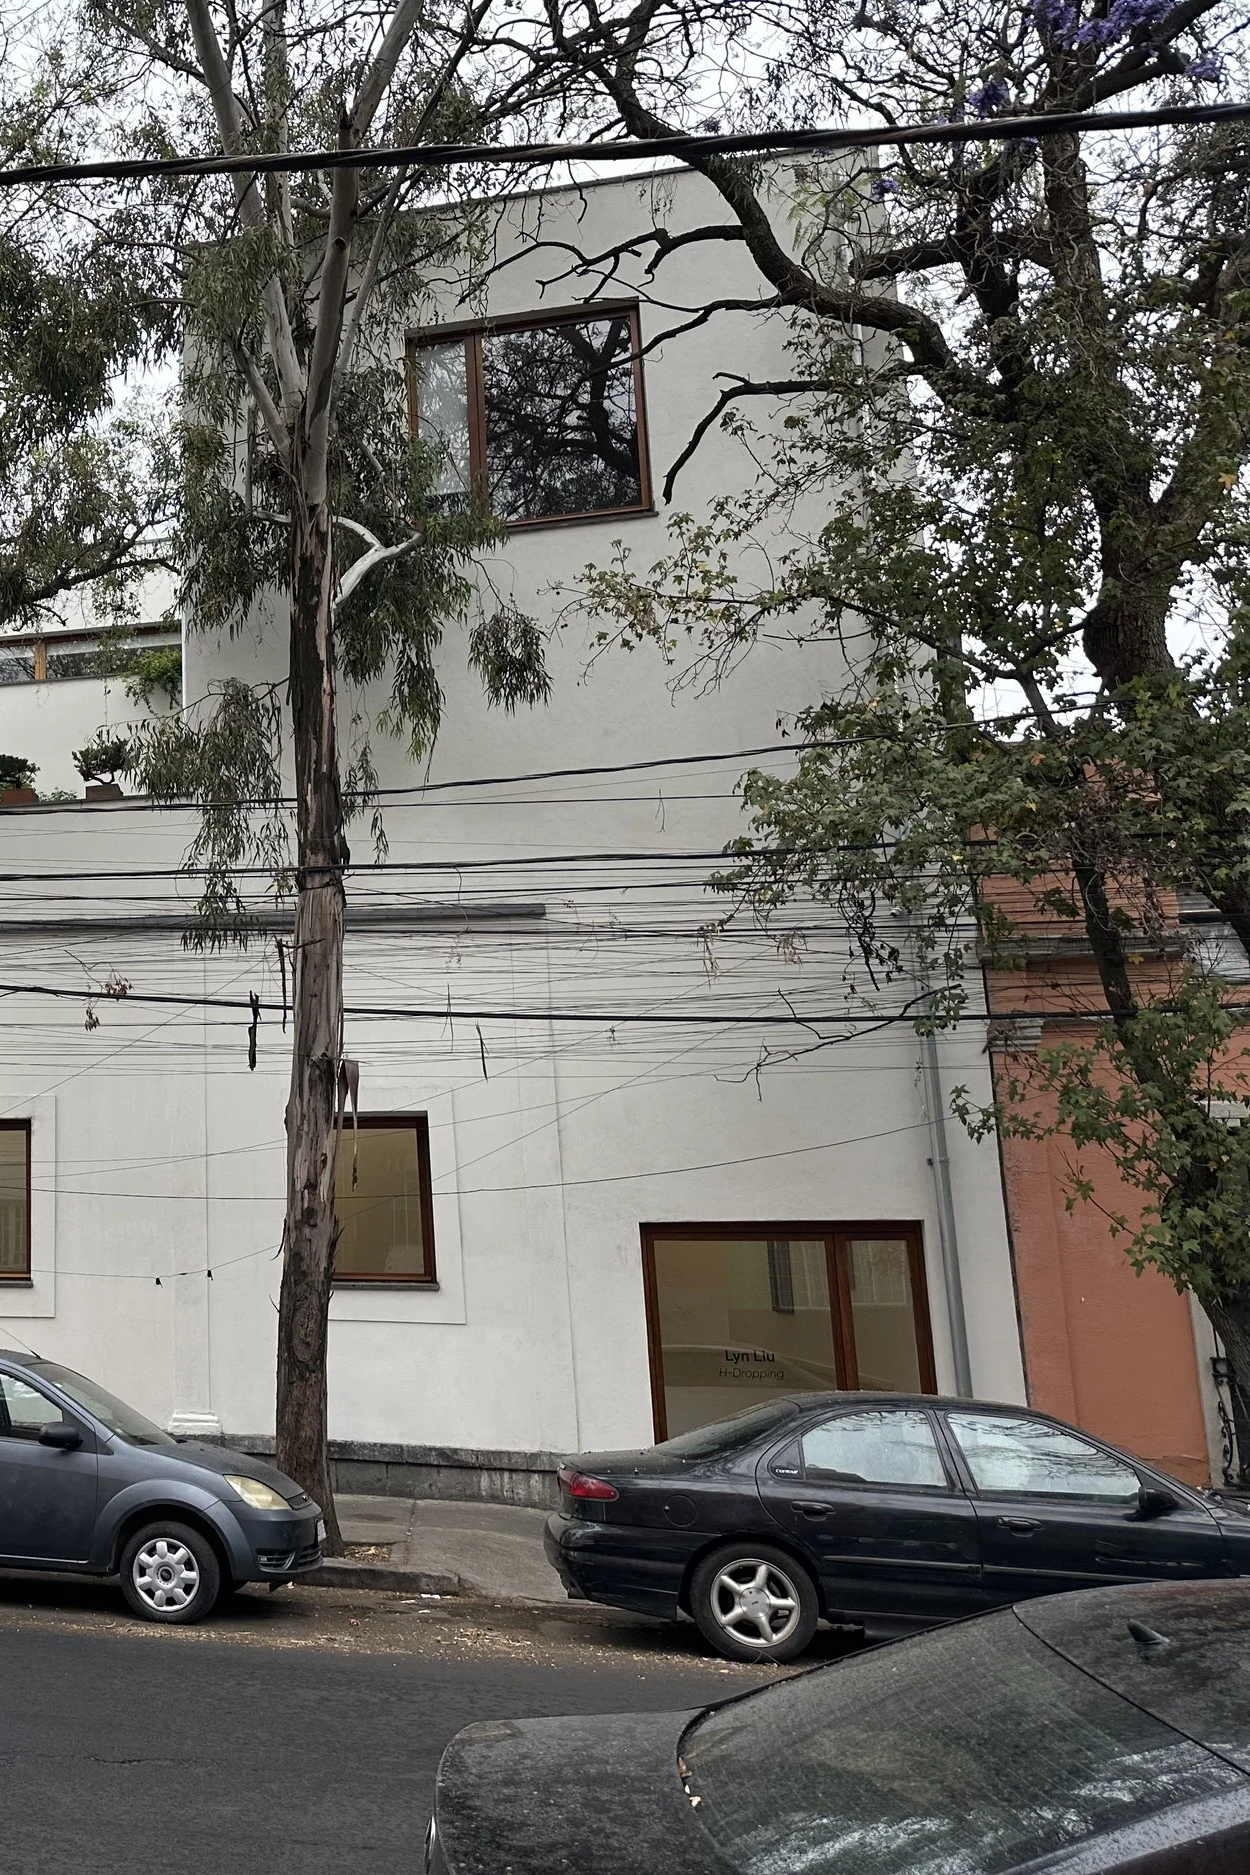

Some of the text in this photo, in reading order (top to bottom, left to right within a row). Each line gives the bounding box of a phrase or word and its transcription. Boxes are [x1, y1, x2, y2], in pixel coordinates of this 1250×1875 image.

[725, 1350, 775, 1364] Lyn Liu
[718, 1367, 784, 1381] H-Dropping
